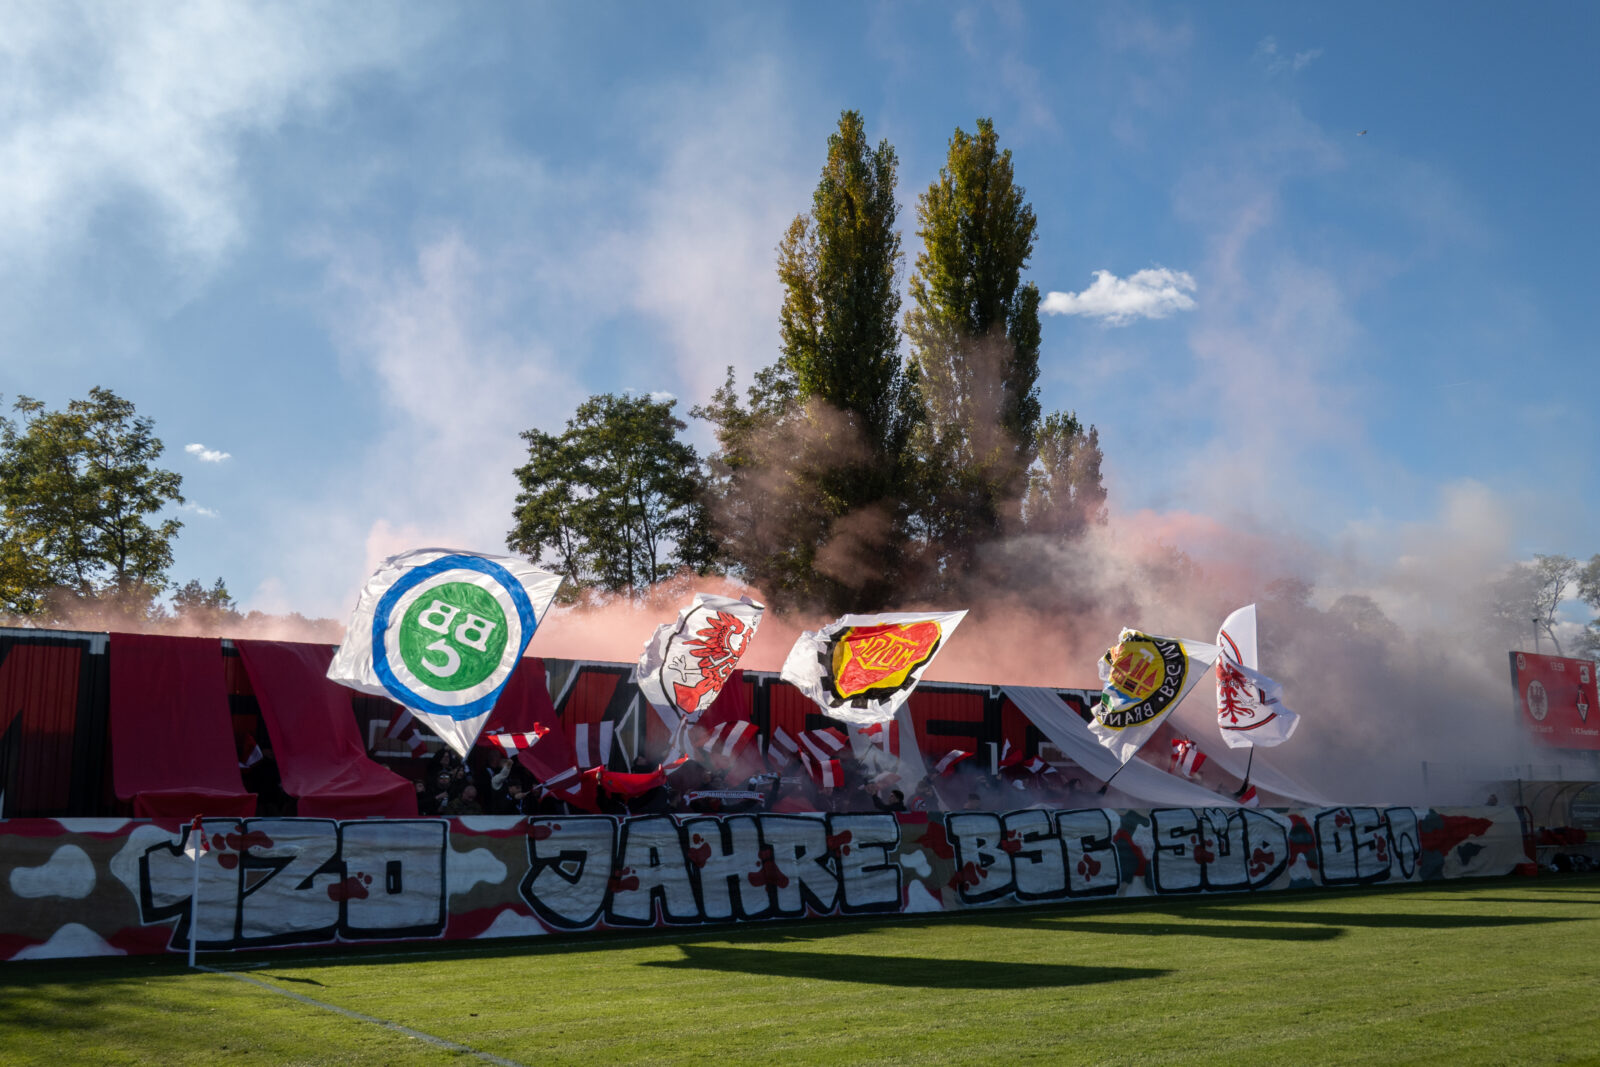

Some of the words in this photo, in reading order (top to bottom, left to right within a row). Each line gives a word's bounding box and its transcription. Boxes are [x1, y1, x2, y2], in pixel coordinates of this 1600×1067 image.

[518, 812, 903, 932] JAHRE
[944, 807, 1120, 906] BSC
[1149, 806, 1291, 898] SÜD
